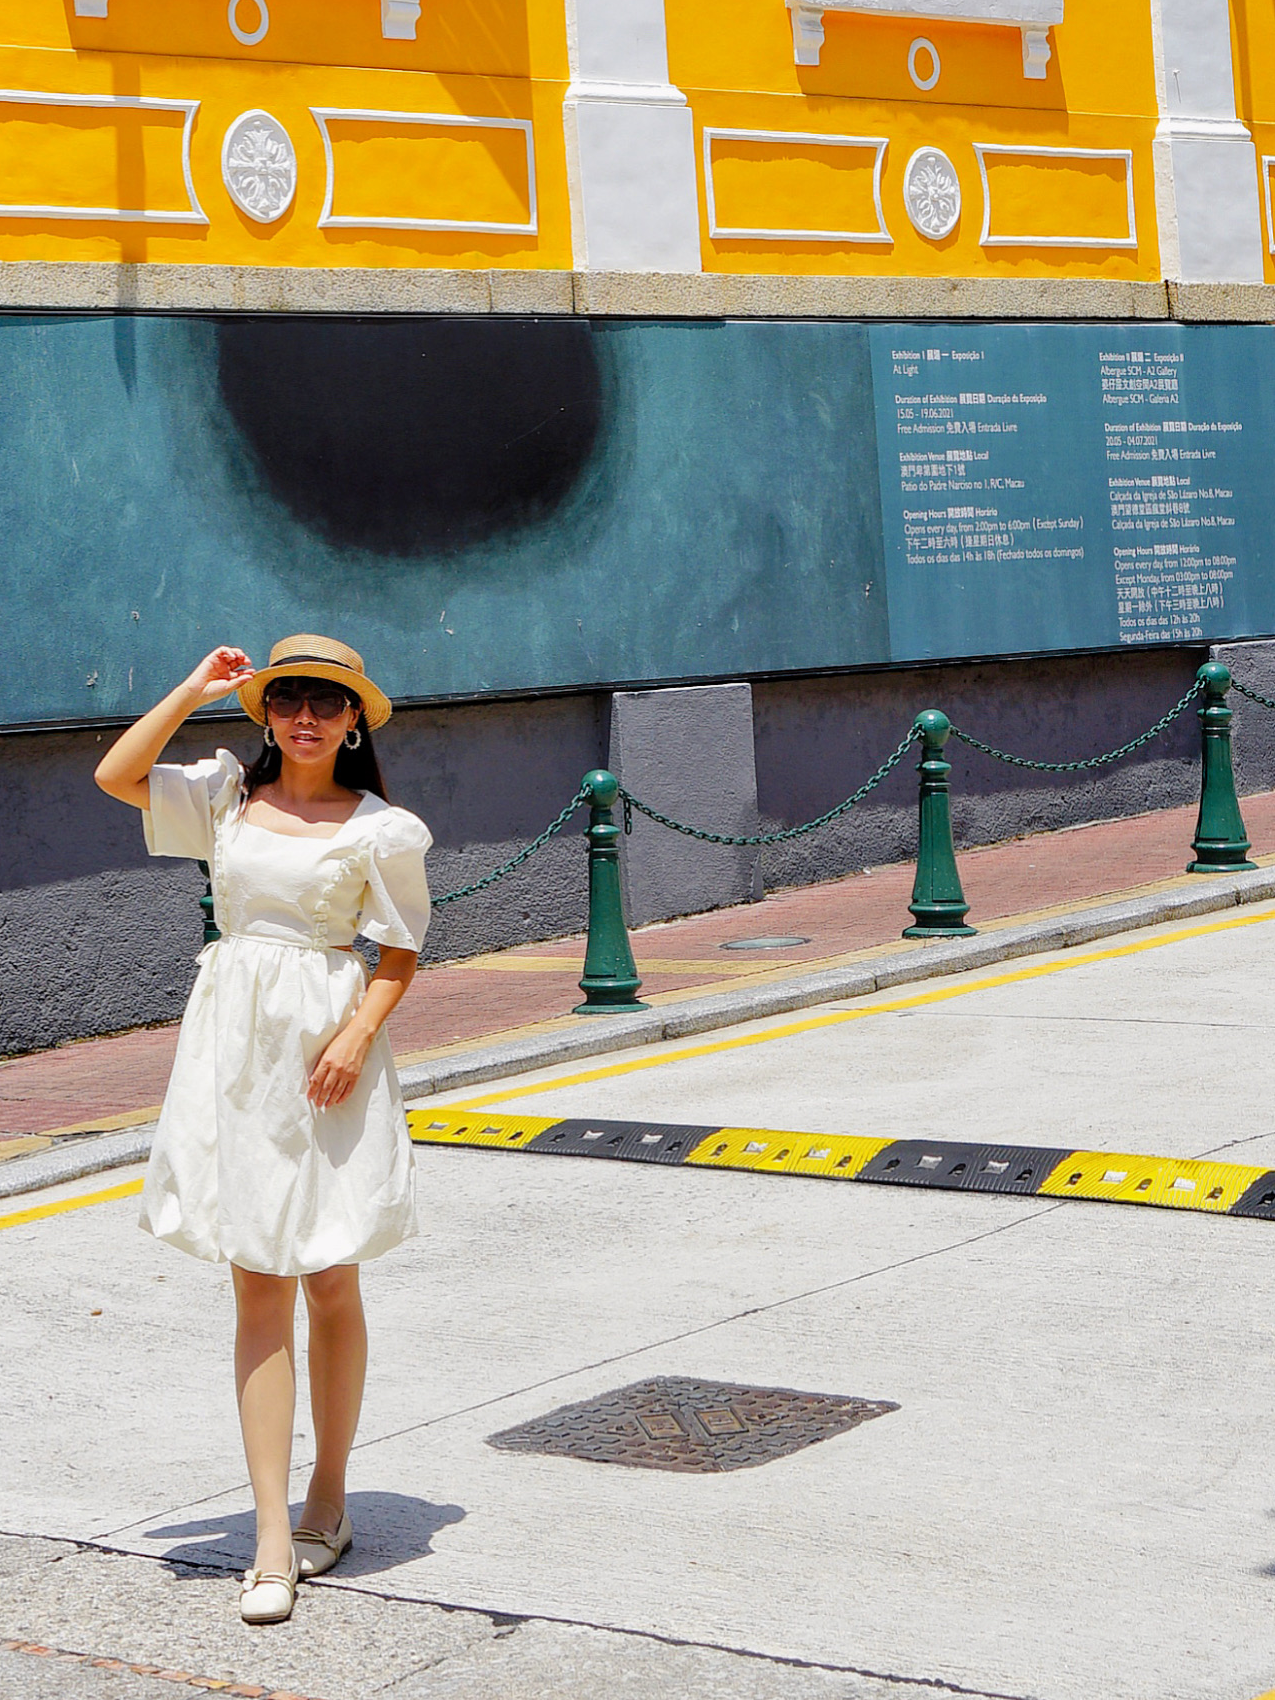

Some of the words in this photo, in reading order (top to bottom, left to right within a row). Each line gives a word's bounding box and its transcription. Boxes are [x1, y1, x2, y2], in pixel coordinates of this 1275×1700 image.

[892, 351, 920, 359] Exhibition
[1099, 352, 1125, 361] Exhibition
[893, 365, 902, 374] At
[903, 364, 918, 377] Light
[1101, 366, 1126, 377] Albergue
[1128, 366, 1141, 375] SCM
[1147, 366, 1155, 375] A2
[1157, 366, 1177, 378] Gallery
[895, 395, 921, 404] Duration
[922, 395, 928, 403] of
[930, 395, 958, 403] Exhibition
[987, 394, 1011, 404] Duração
[1012, 394, 1019, 402] da
[1019, 393, 1047, 404] Exposição
[1103, 394, 1129, 406] Albergue
[1130, 394, 1144, 403] SCM
[1149, 394, 1169, 403] Galeria
[1170, 393, 1178, 403] A2
[897, 423, 911, 433] Free
[913, 424, 944, 433] Admission
[947, 422, 976, 433] 免費入場
[978, 422, 1001, 432] Entrada
[1003, 422, 1017, 432] Livre
[1105, 423, 1128, 432] Duration
[1129, 423, 1135, 431] of
[1136, 423, 1161, 431] Exhibition
[1188, 422, 1210, 432] Duração
[1211, 422, 1217, 431] da
[1217, 422, 1242, 432] Exposição
[899, 453, 928, 461] Exhibition
[927, 452, 945, 461] Venue
[974, 451, 989, 460] Local
[1107, 450, 1120, 460] Free
[1121, 451, 1150, 460] Admission
[1180, 449, 1201, 459] Entrada
[1202, 449, 1216, 459] Livre
[919, 481, 928, 490] do
[929, 480, 947, 490] Padre
[948, 480, 972, 490] Narciso
[1005, 478, 1024, 488] Macau
[1109, 478, 1134, 487] Exhibition
[1135, 478, 1150, 486] Venue
[1177, 477, 1190, 485] Local
[1110, 491, 1132, 502] Calçada
[1134, 492, 1140, 500] da
[1142, 492, 1157, 501] Igreja
[1159, 491, 1165, 499] de
[1215, 488, 1232, 497] Macau
[903, 510, 929, 521] Opening
[928, 510, 946, 518] Hours
[1112, 519, 1134, 530] Calçada
[1136, 520, 1143, 528] da
[1144, 520, 1159, 530] Igreja
[1161, 519, 1168, 527] de
[1217, 516, 1235, 525] Macau
[904, 524, 925, 536] Opens
[927, 525, 945, 536] every
[959, 522, 973, 532] from
[999, 522, 1006, 530] to
[906, 554, 925, 564] Todos
[936, 553, 948, 563] dias
[950, 553, 960, 562] das
[963, 552, 974, 561] 14h
[1026, 548, 1043, 558] todos
[1114, 547, 1136, 557] Opening
[1137, 546, 1153, 555] Hours
[1115, 560, 1134, 572] Opens
[1135, 562, 1151, 572] every
[1164, 559, 1178, 567] from
[1116, 574, 1135, 585] Except
[1161, 573, 1174, 581] from
[1119, 617, 1136, 627] Todos
[1158, 616, 1168, 625] das
[1161, 630, 1170, 639] das
